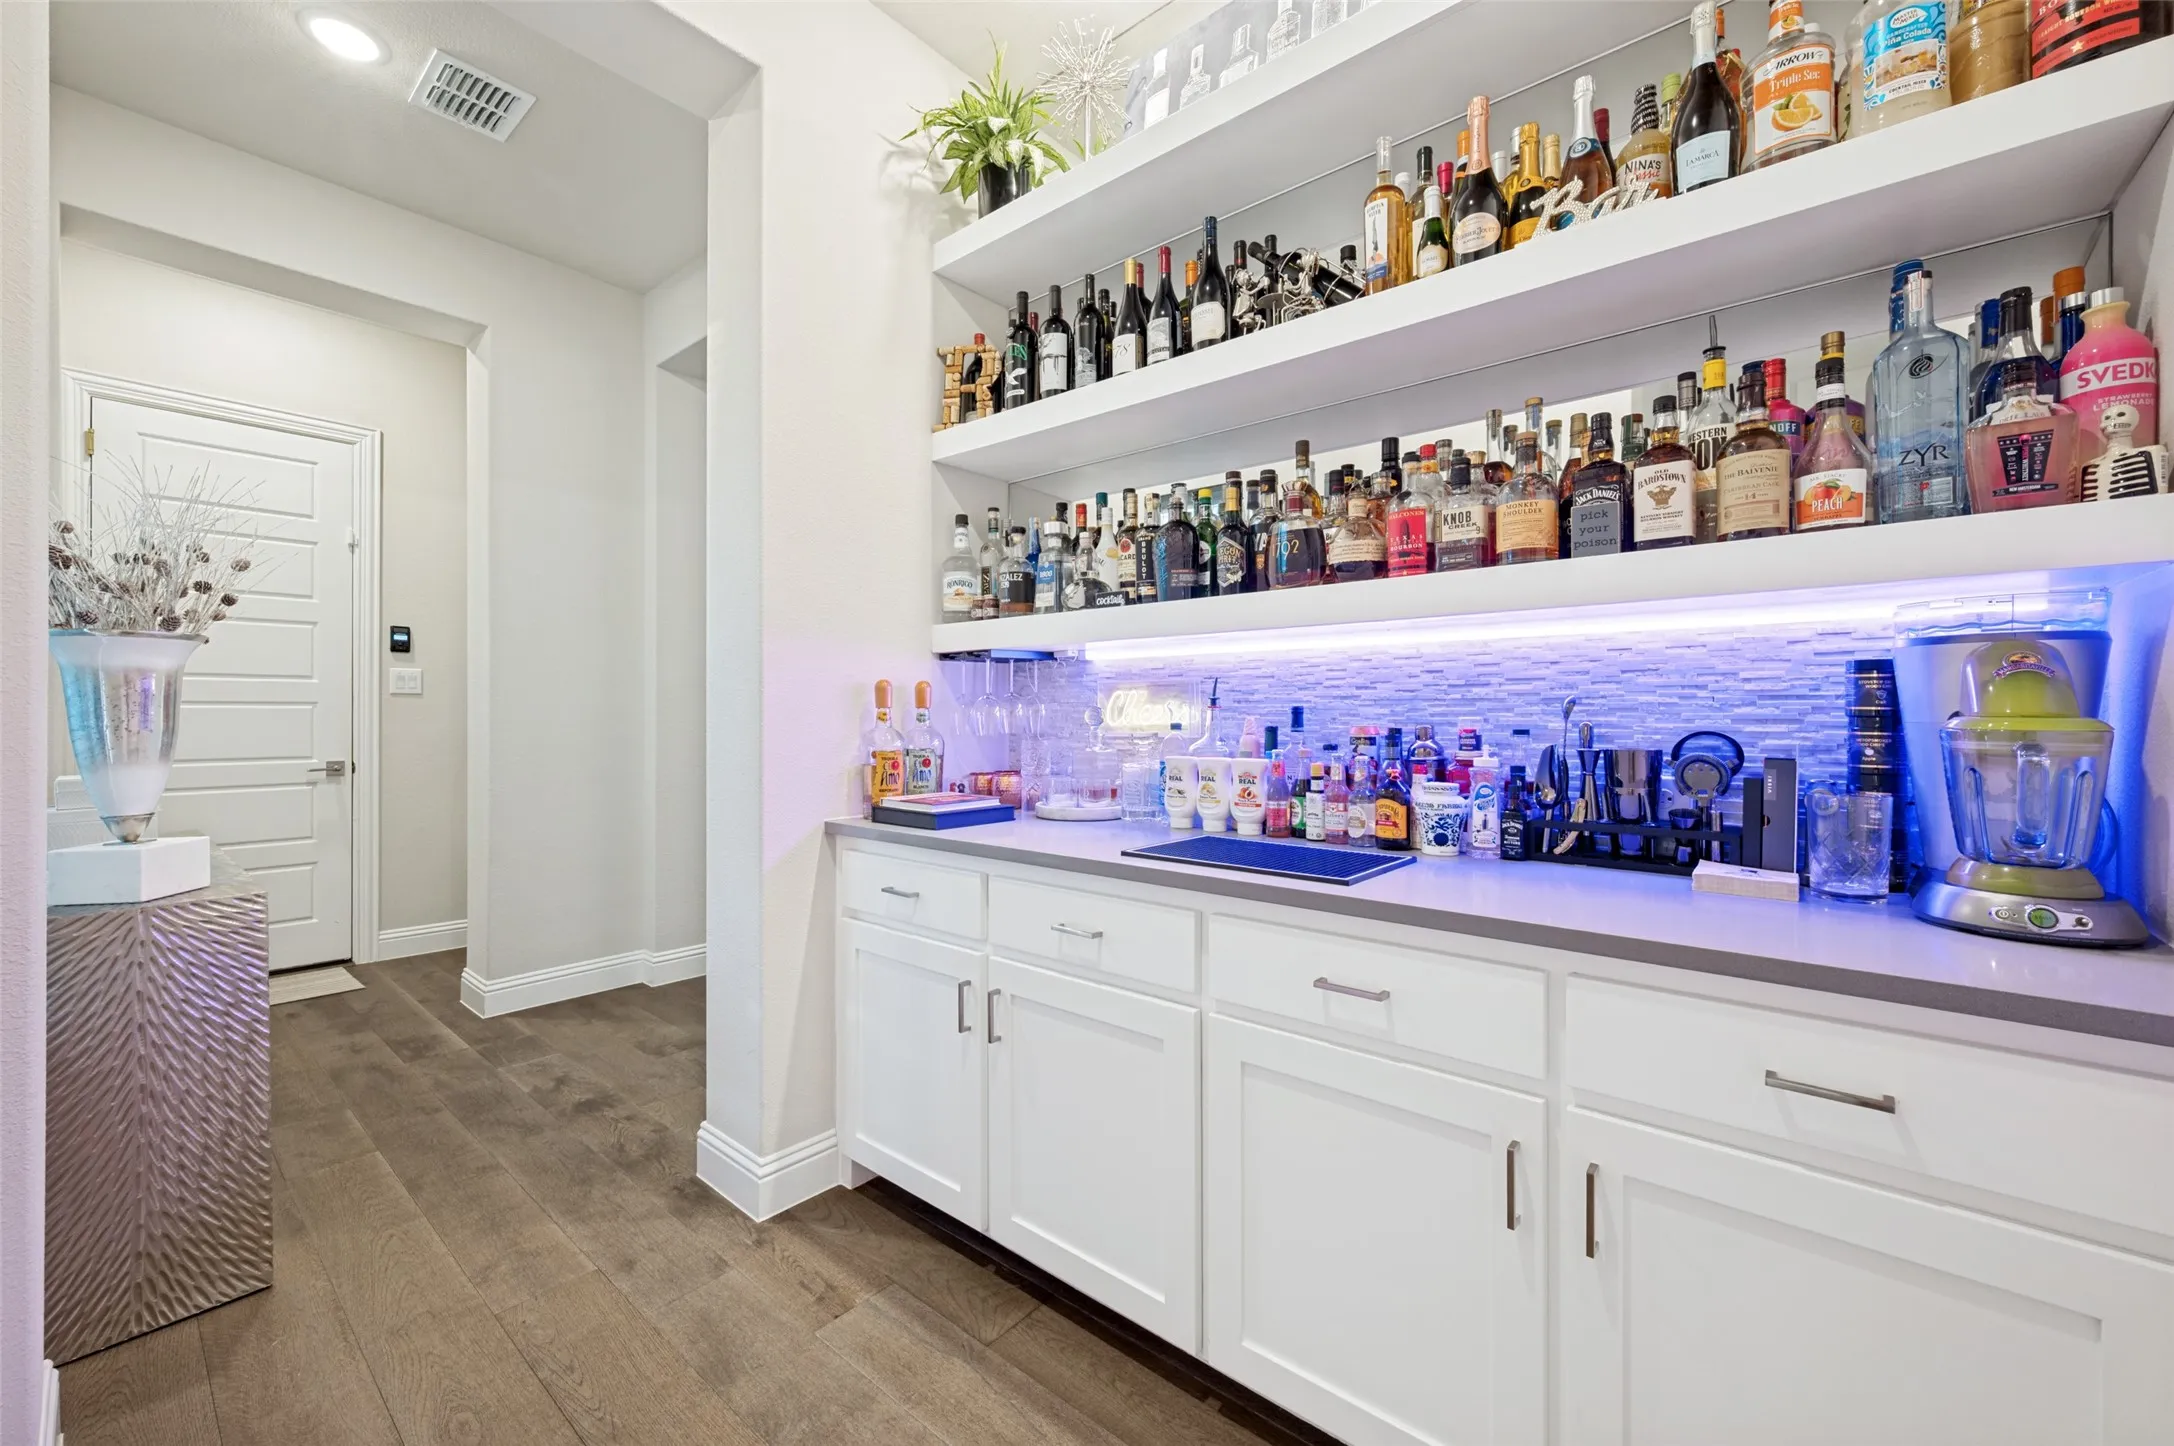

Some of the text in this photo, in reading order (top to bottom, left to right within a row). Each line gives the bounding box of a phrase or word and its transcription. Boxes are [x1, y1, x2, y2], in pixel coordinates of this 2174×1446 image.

[1903, 27, 1932, 40] Colada
[1764, 50, 1824, 76] ARROW
[1769, 69, 1821, 93] Triple Sec
[1694, 149, 1720, 163] MARCA
[1624, 159, 1662, 175] NINA'S
[2097, 392, 2153, 404] STRAWBERRY
[1898, 442, 1950, 467] ZYR
[1737, 465, 1778, 477] BALVENIE
[1637, 472, 1687, 490] BARDSTOWN
[1576, 488, 1620, 506] JACK DANIEL'S
[1506, 500, 1539, 509] MONKEY
[1811, 496, 1843, 513] PEACH
[1443, 510, 1472, 526] KNOB
[1503, 507, 1543, 518] SHOULDER
[1581, 509, 1609, 522] pick
[1448, 522, 1478, 530] CREEK
[1579, 524, 1610, 536] your
[1574, 538, 1618, 551] poison
